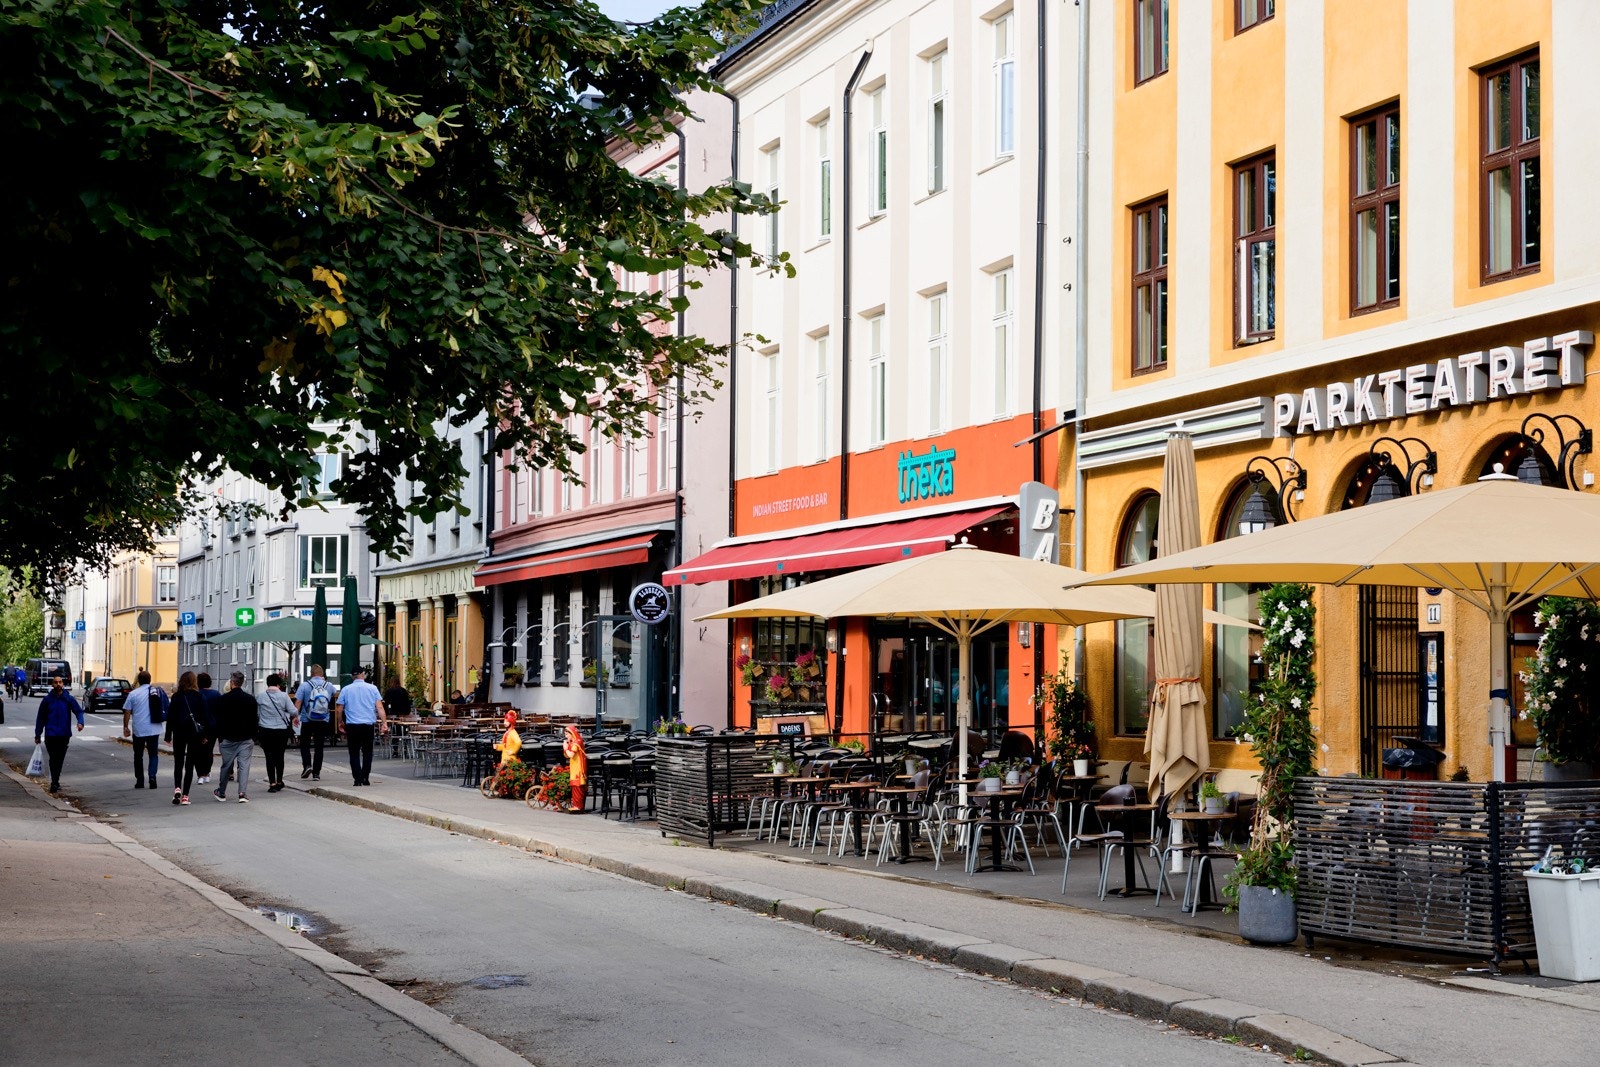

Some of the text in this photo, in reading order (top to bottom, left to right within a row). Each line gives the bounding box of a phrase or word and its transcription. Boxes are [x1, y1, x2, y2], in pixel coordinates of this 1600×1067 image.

[1273, 330, 1592, 437] PARKTEATRET
[897, 444, 956, 504] theka
[752, 493, 828, 517] INDIAN STREET FOOD & BAR
[77, 622, 84, 630] P
[184, 613, 192, 624] P
